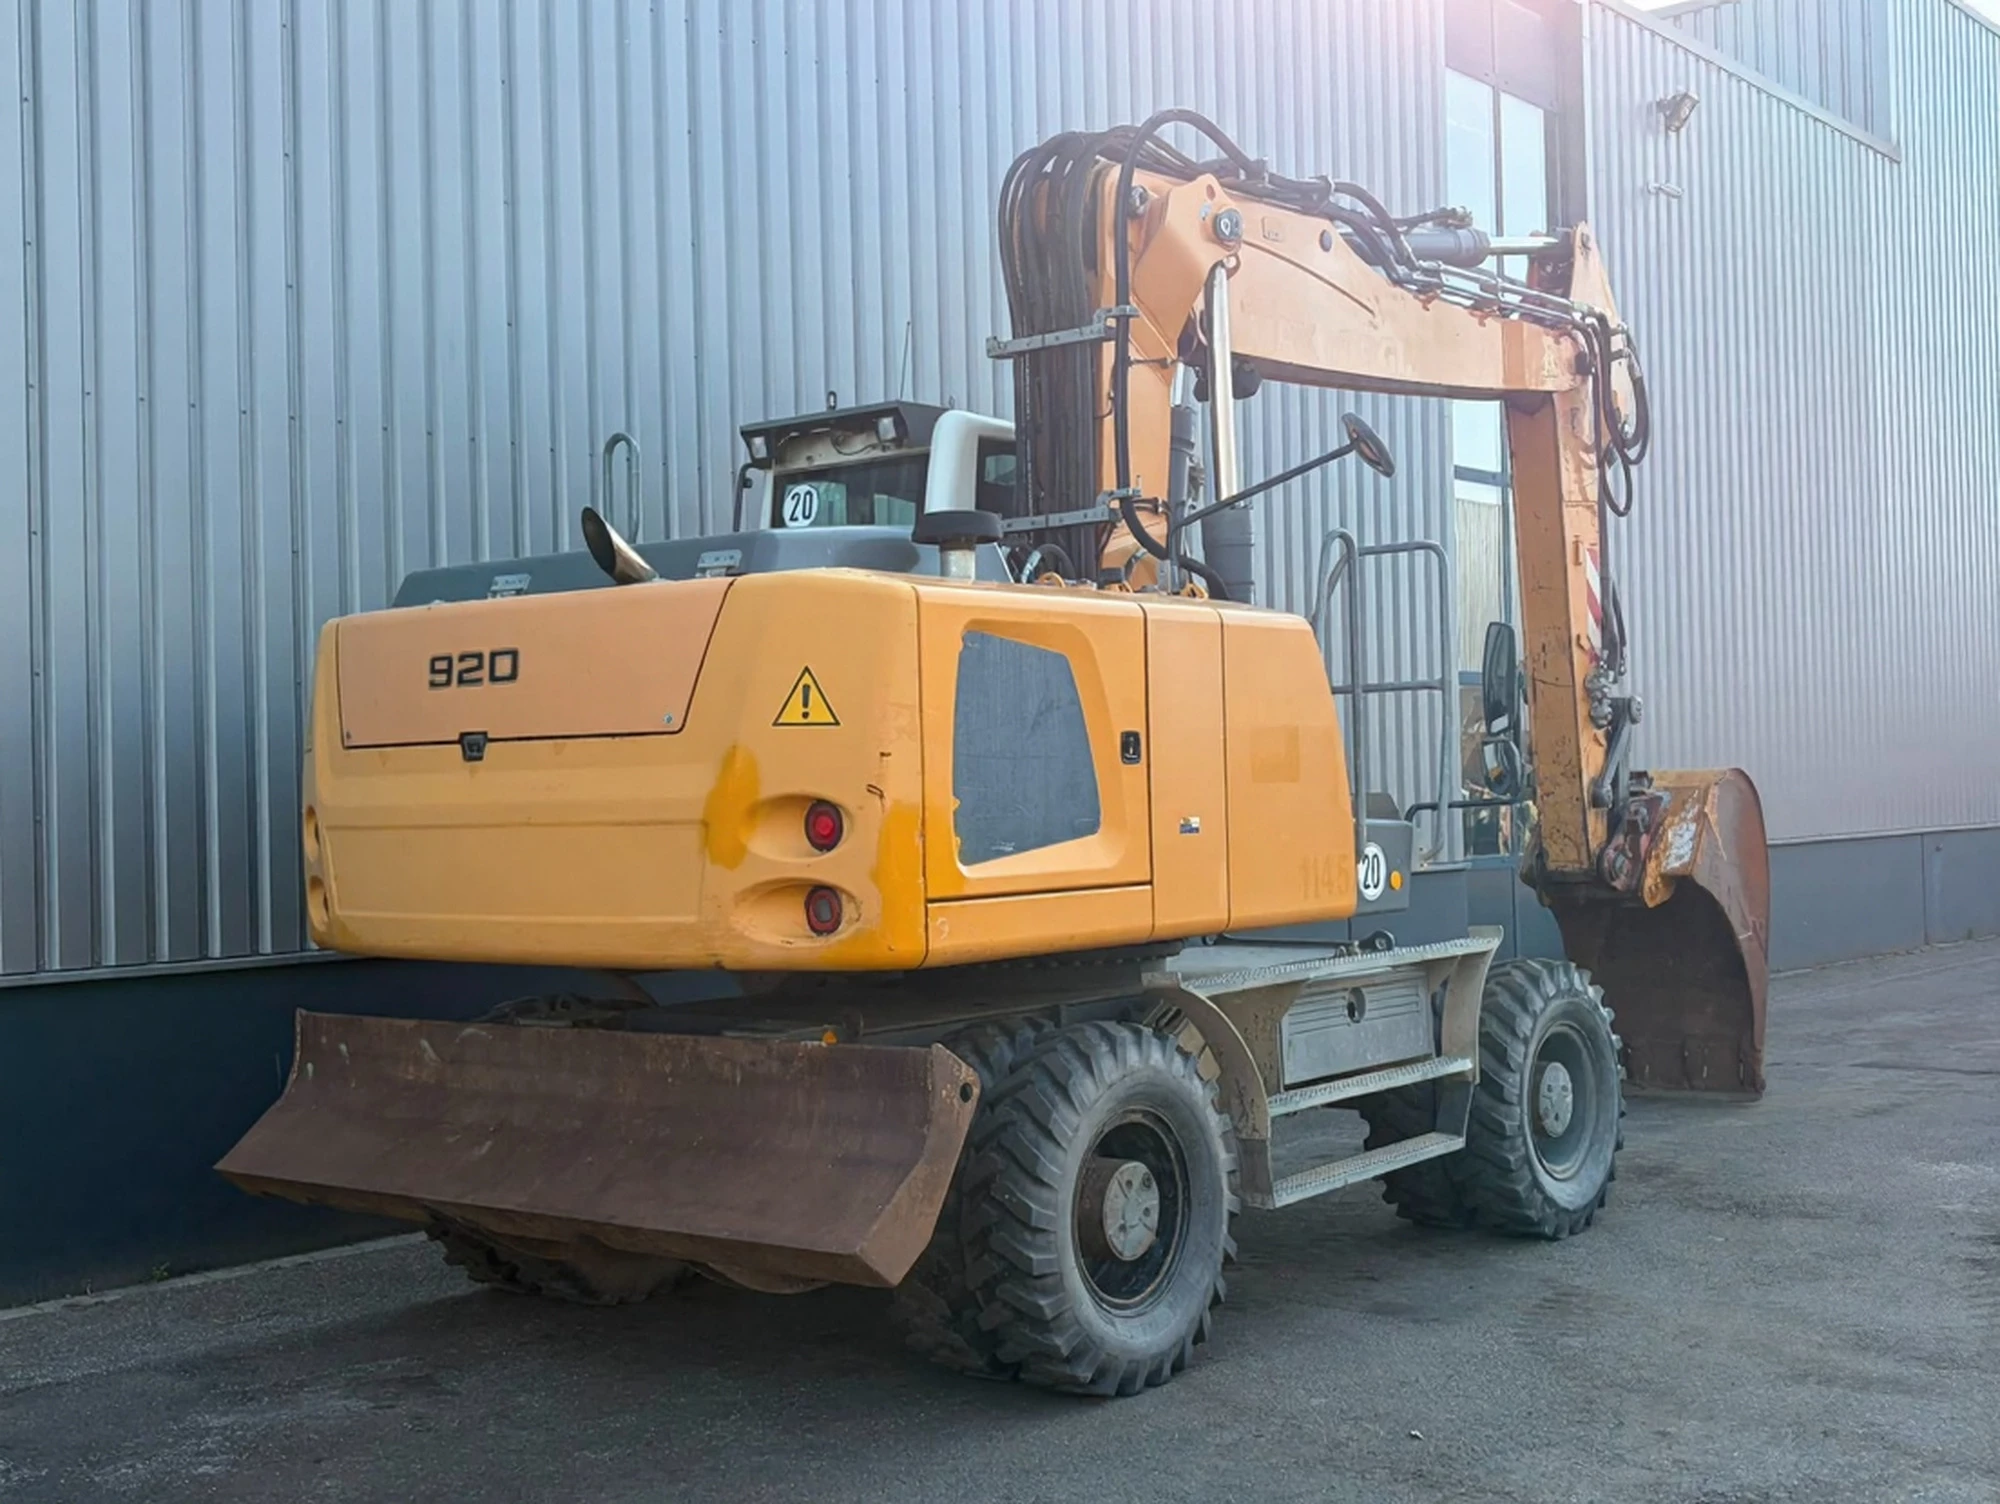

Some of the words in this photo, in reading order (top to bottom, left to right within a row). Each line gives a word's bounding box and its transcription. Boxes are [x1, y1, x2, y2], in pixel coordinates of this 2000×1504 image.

[790, 490, 813, 521] 20
[428, 648, 519, 688] 920
[1362, 854, 1381, 890] 20
